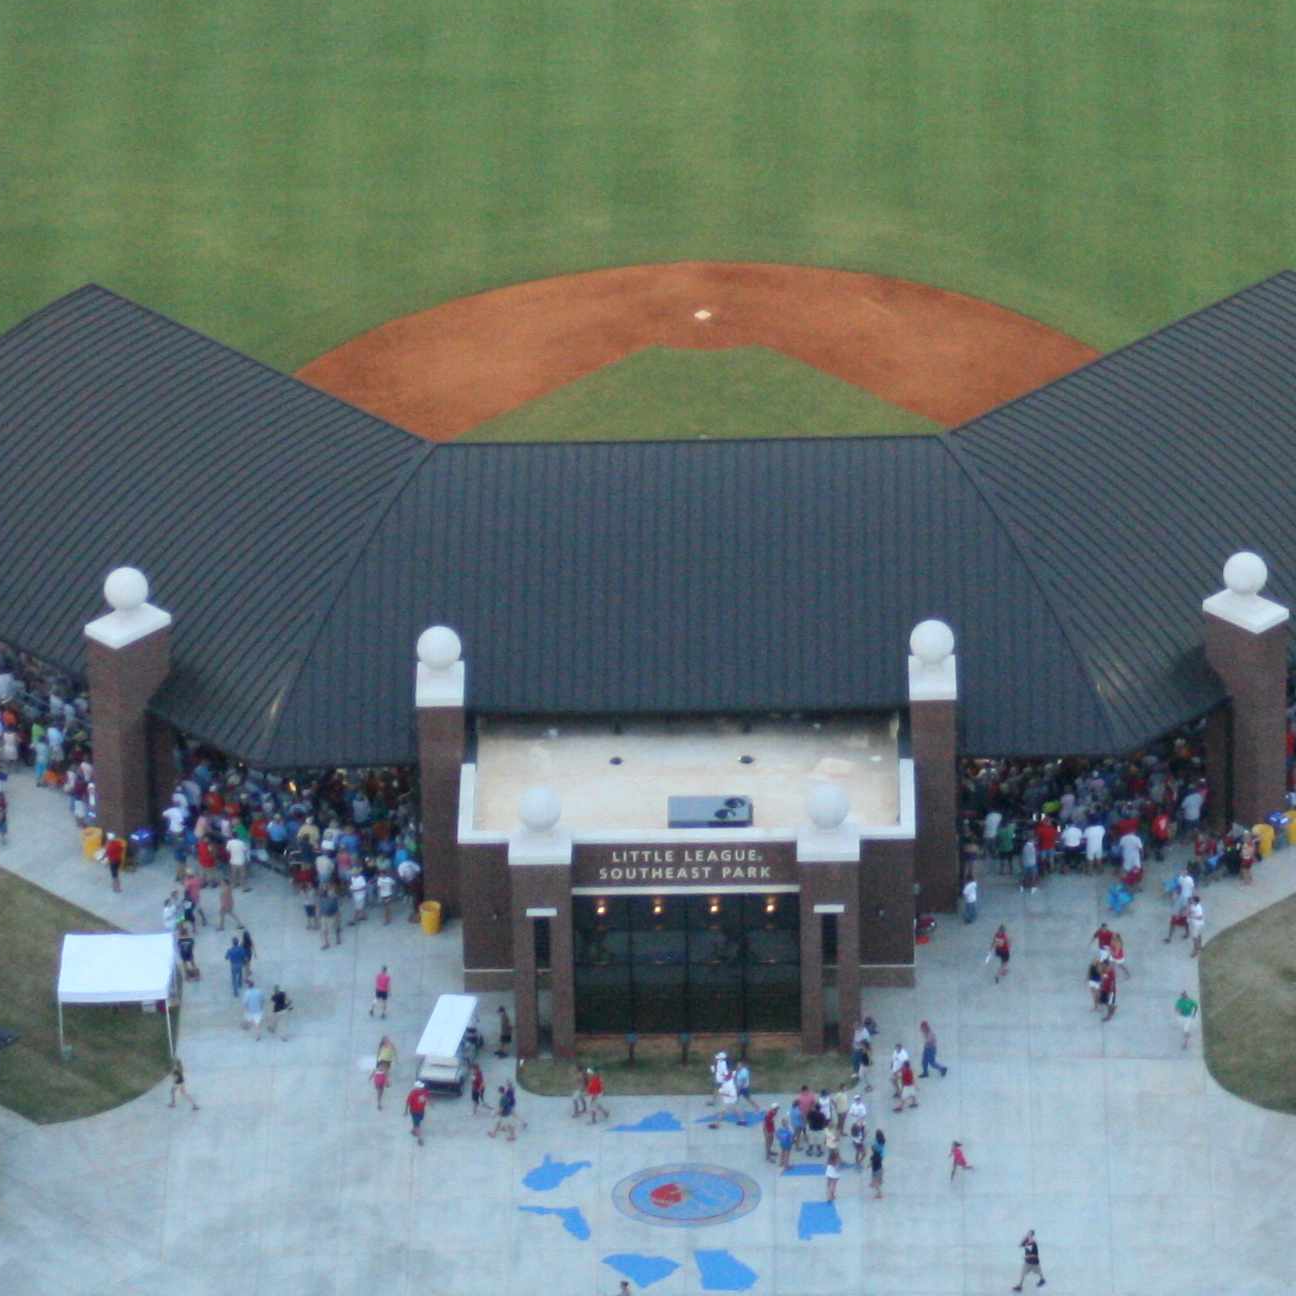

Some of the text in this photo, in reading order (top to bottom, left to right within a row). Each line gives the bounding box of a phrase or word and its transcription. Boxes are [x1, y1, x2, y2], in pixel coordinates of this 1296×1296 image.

[612, 850, 673, 862] LITTLE
[599, 866, 771, 880] SOUTHEAST PARK
